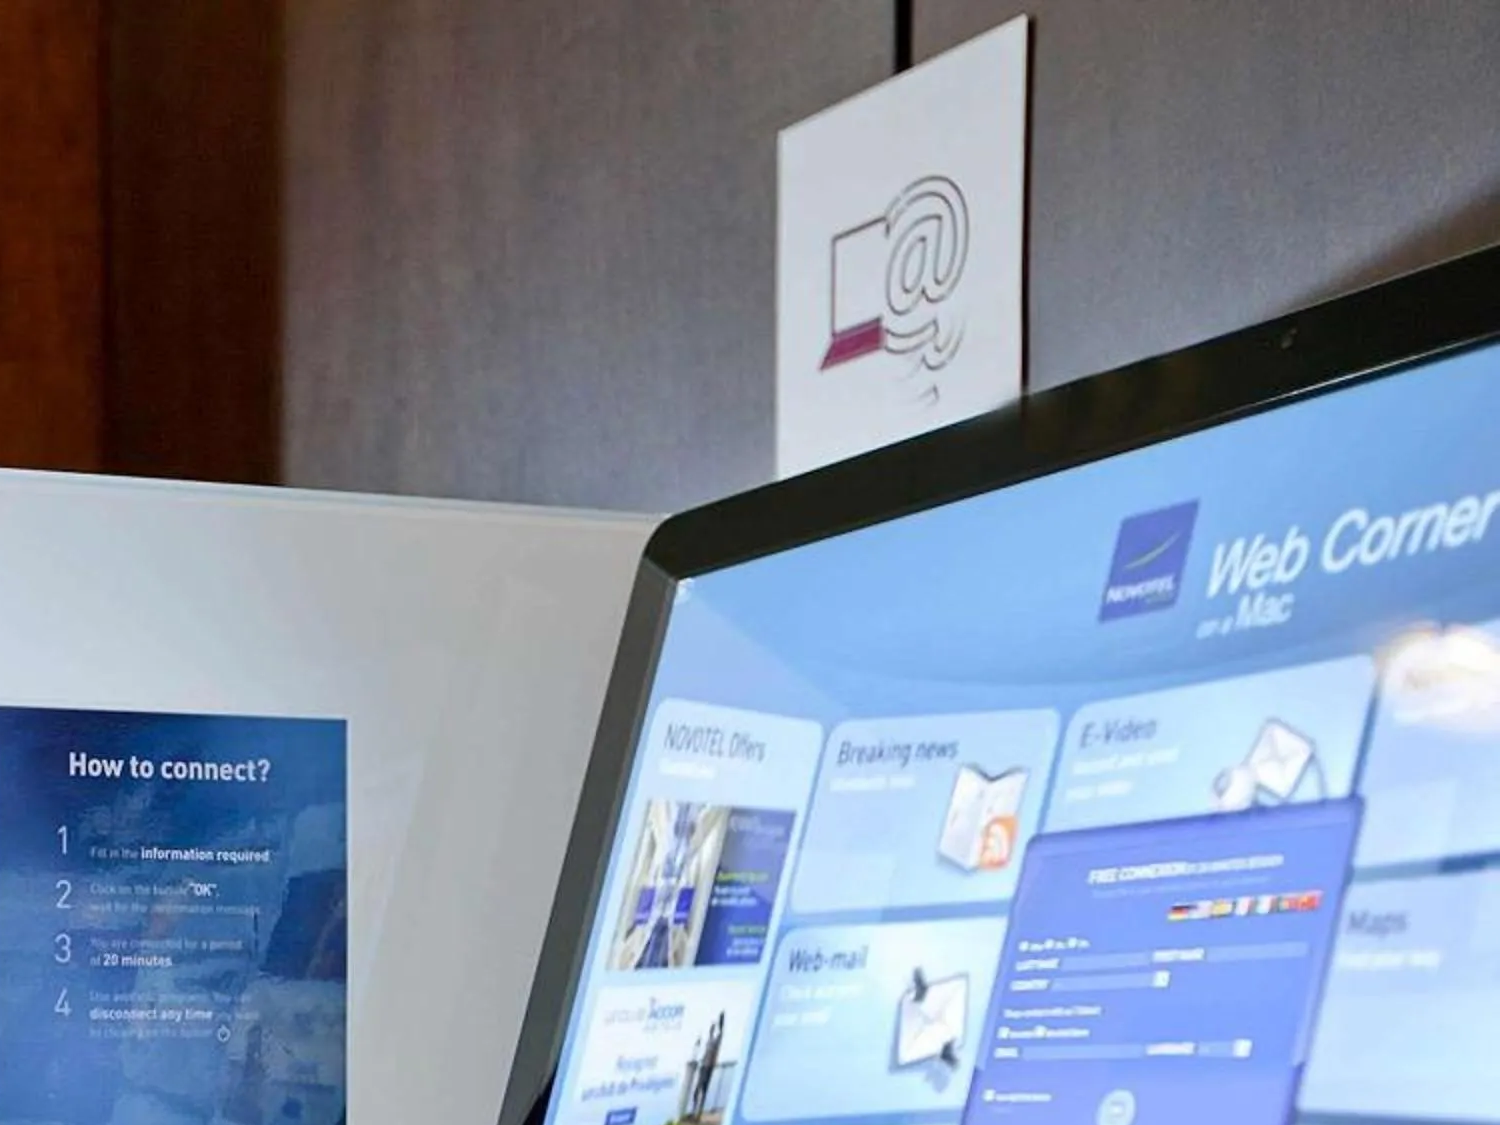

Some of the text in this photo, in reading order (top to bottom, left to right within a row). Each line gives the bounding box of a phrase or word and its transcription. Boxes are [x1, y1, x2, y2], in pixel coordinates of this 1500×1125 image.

[1206, 489, 1500, 598] Web Corner
[1234, 592, 1295, 629] Mac
[663, 721, 723, 758] NOVOTEL
[836, 739, 960, 769] Breaking news
[68, 752, 272, 782] How to connect?
[56, 825, 68, 855] 1
[140, 846, 214, 861] information
[54, 879, 73, 910] 2
[1347, 909, 1411, 938] Maps
[54, 933, 72, 964] 3
[103, 953, 119, 967] 20
[788, 943, 870, 973] Web-mail
[54, 988, 72, 1018] 4
[89, 1007, 157, 1021] disconnect
[160, 1009, 184, 1023] any
[185, 1008, 213, 1021] time
